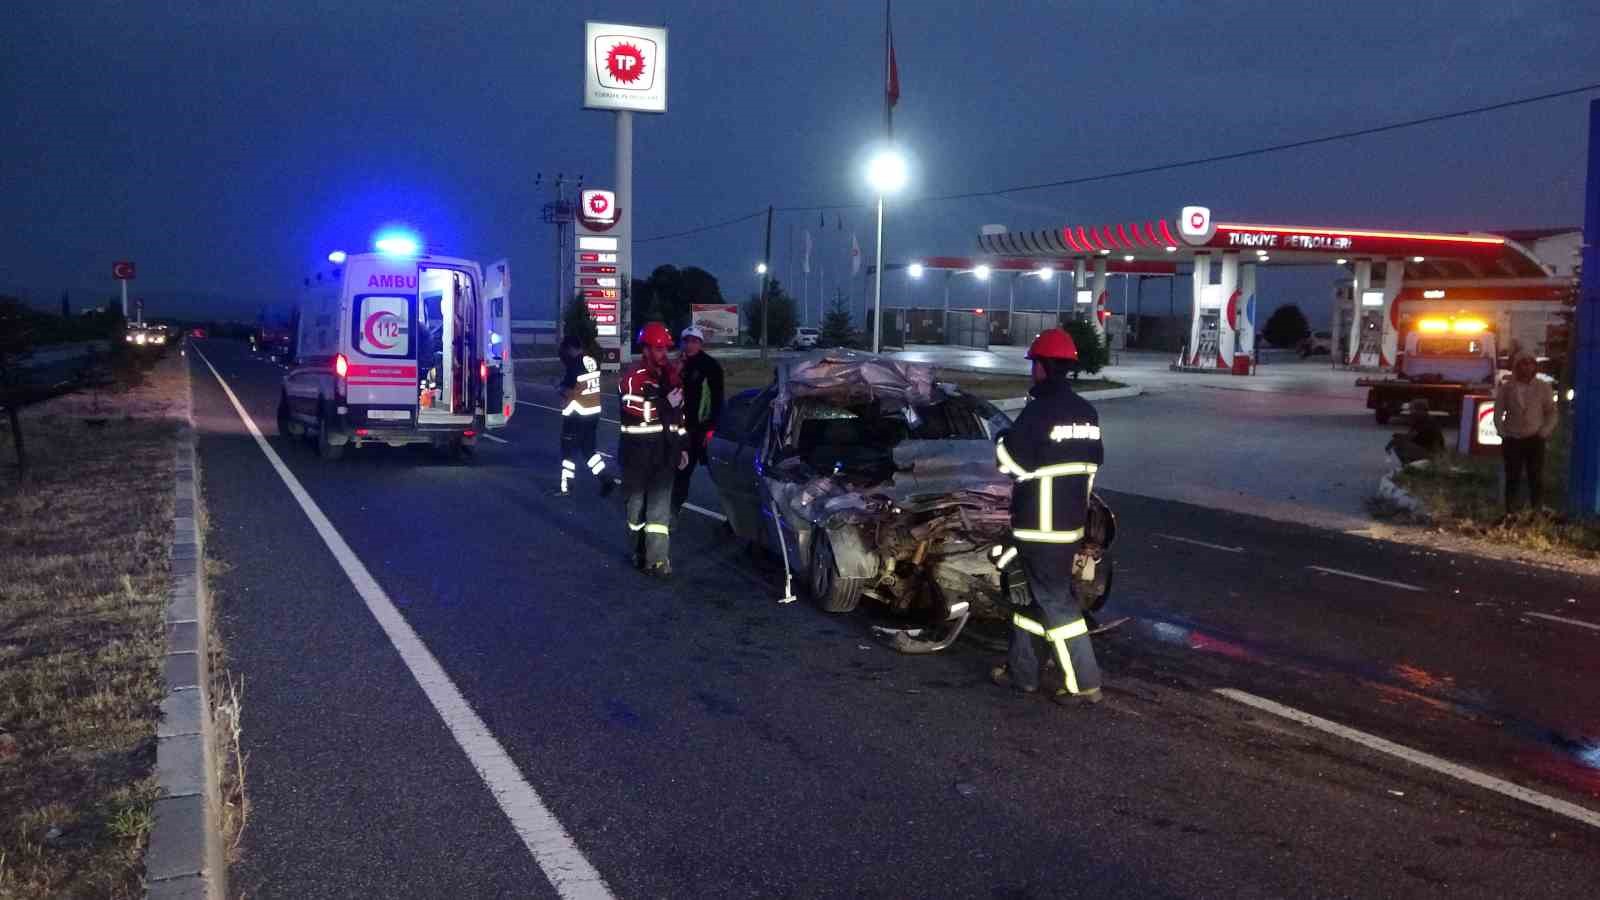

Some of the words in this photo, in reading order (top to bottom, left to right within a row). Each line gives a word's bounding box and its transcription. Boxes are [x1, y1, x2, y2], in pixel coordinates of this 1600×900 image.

[615, 54, 637, 71] TP
[367, 273, 417, 289] AMBU
[376, 321, 399, 337] 112
